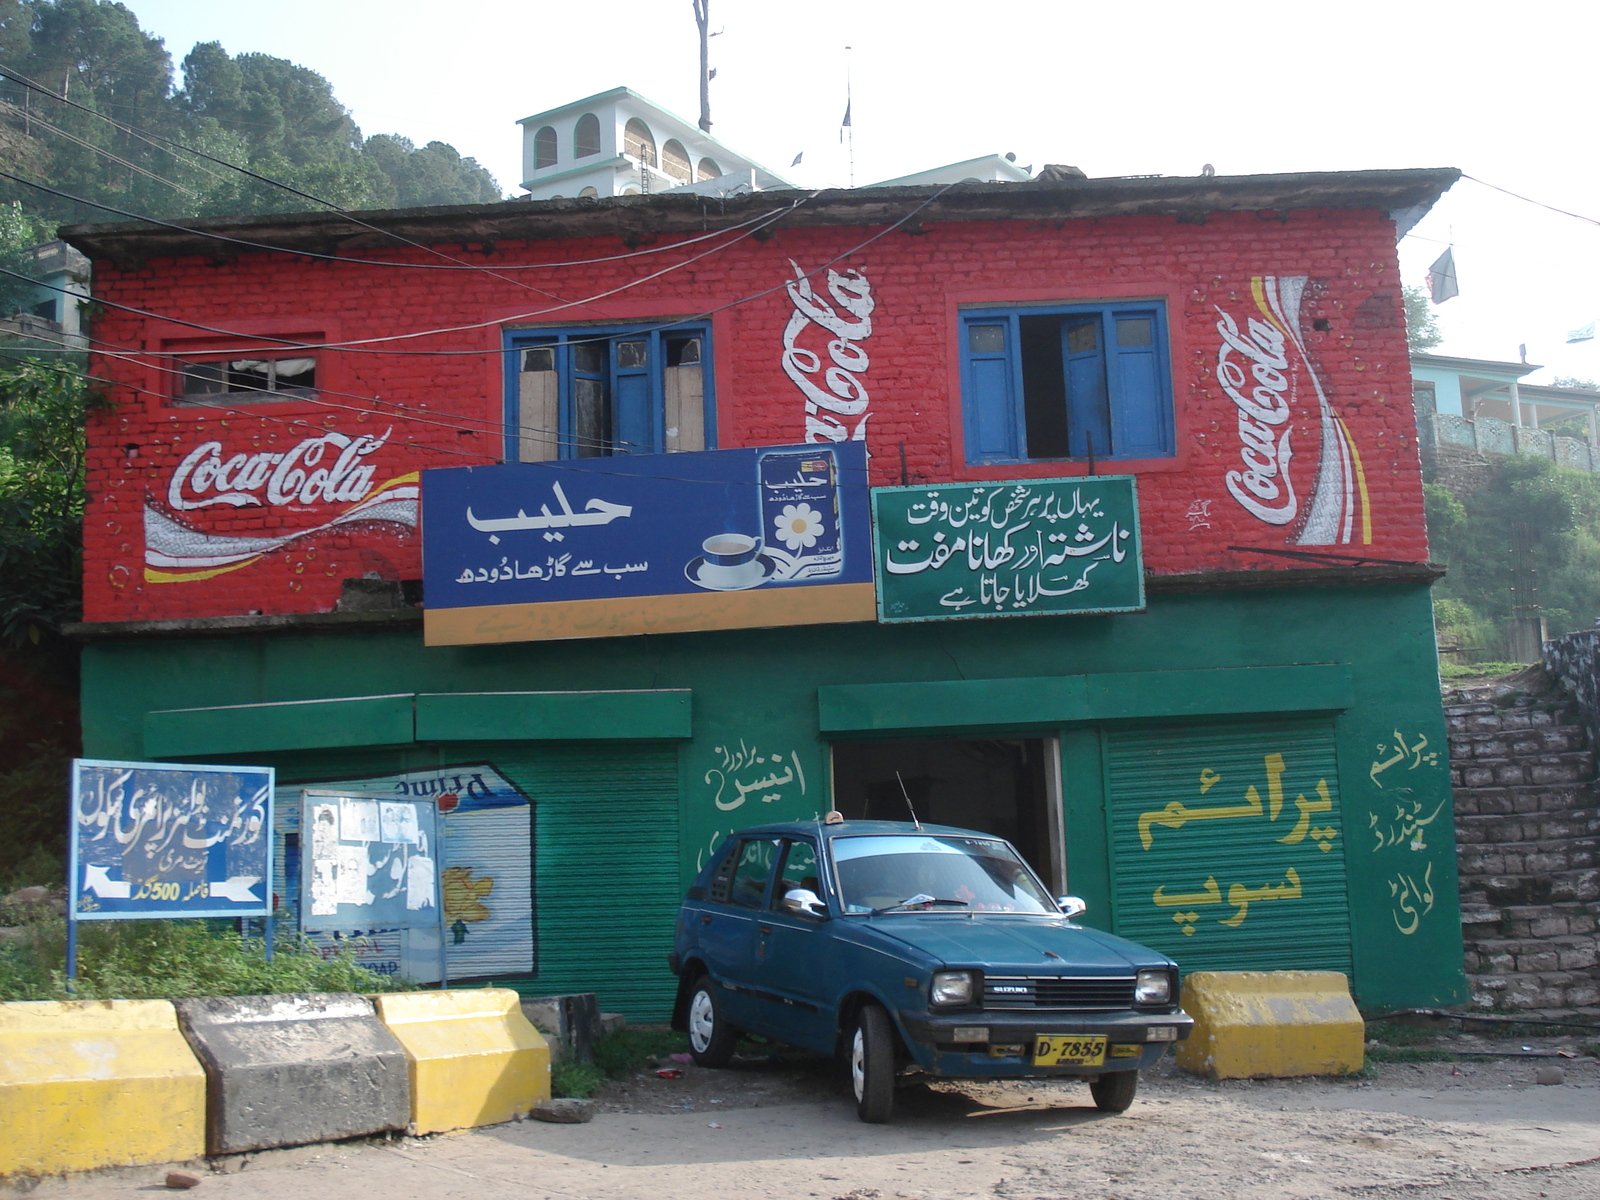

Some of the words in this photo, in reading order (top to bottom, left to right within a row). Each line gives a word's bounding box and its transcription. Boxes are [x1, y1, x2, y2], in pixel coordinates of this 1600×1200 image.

[1214, 304, 1297, 526] Coca-Cola
[167, 425, 393, 511] Coca-Cola
[466, 480, 633, 545] حلیب
[907, 491, 948, 524] وقت
[949, 487, 985, 527] تین
[978, 487, 1004, 523] کو
[991, 485, 1031, 529] شخص
[1021, 493, 1042, 519] ہر
[1038, 491, 1057, 523] پر
[1057, 487, 1104, 519] یہاں
[886, 531, 966, 575] مفت
[968, 521, 1031, 571] کھانا
[1010, 530, 1043, 570] اور
[1041, 521, 1131, 570] ناشتہ
[515, 552, 572, 581] گاڑھا
[571, 559, 602, 576] سے
[603, 560, 649, 580] سب
[939, 586, 977, 611] ہے
[980, 572, 1010, 611] جاتا
[714, 738, 766, 774] برادرز
[395, 773, 497, 800] Prime
[704, 750, 806, 811] انیس
[1137, 752, 1338, 853] پرائم
[150, 881, 181, 902] 500
[1152, 867, 1303, 936] سوپ
[1387, 861, 1434, 935] کوالٹی
[993, 986, 1028, 994] SUZUKI
